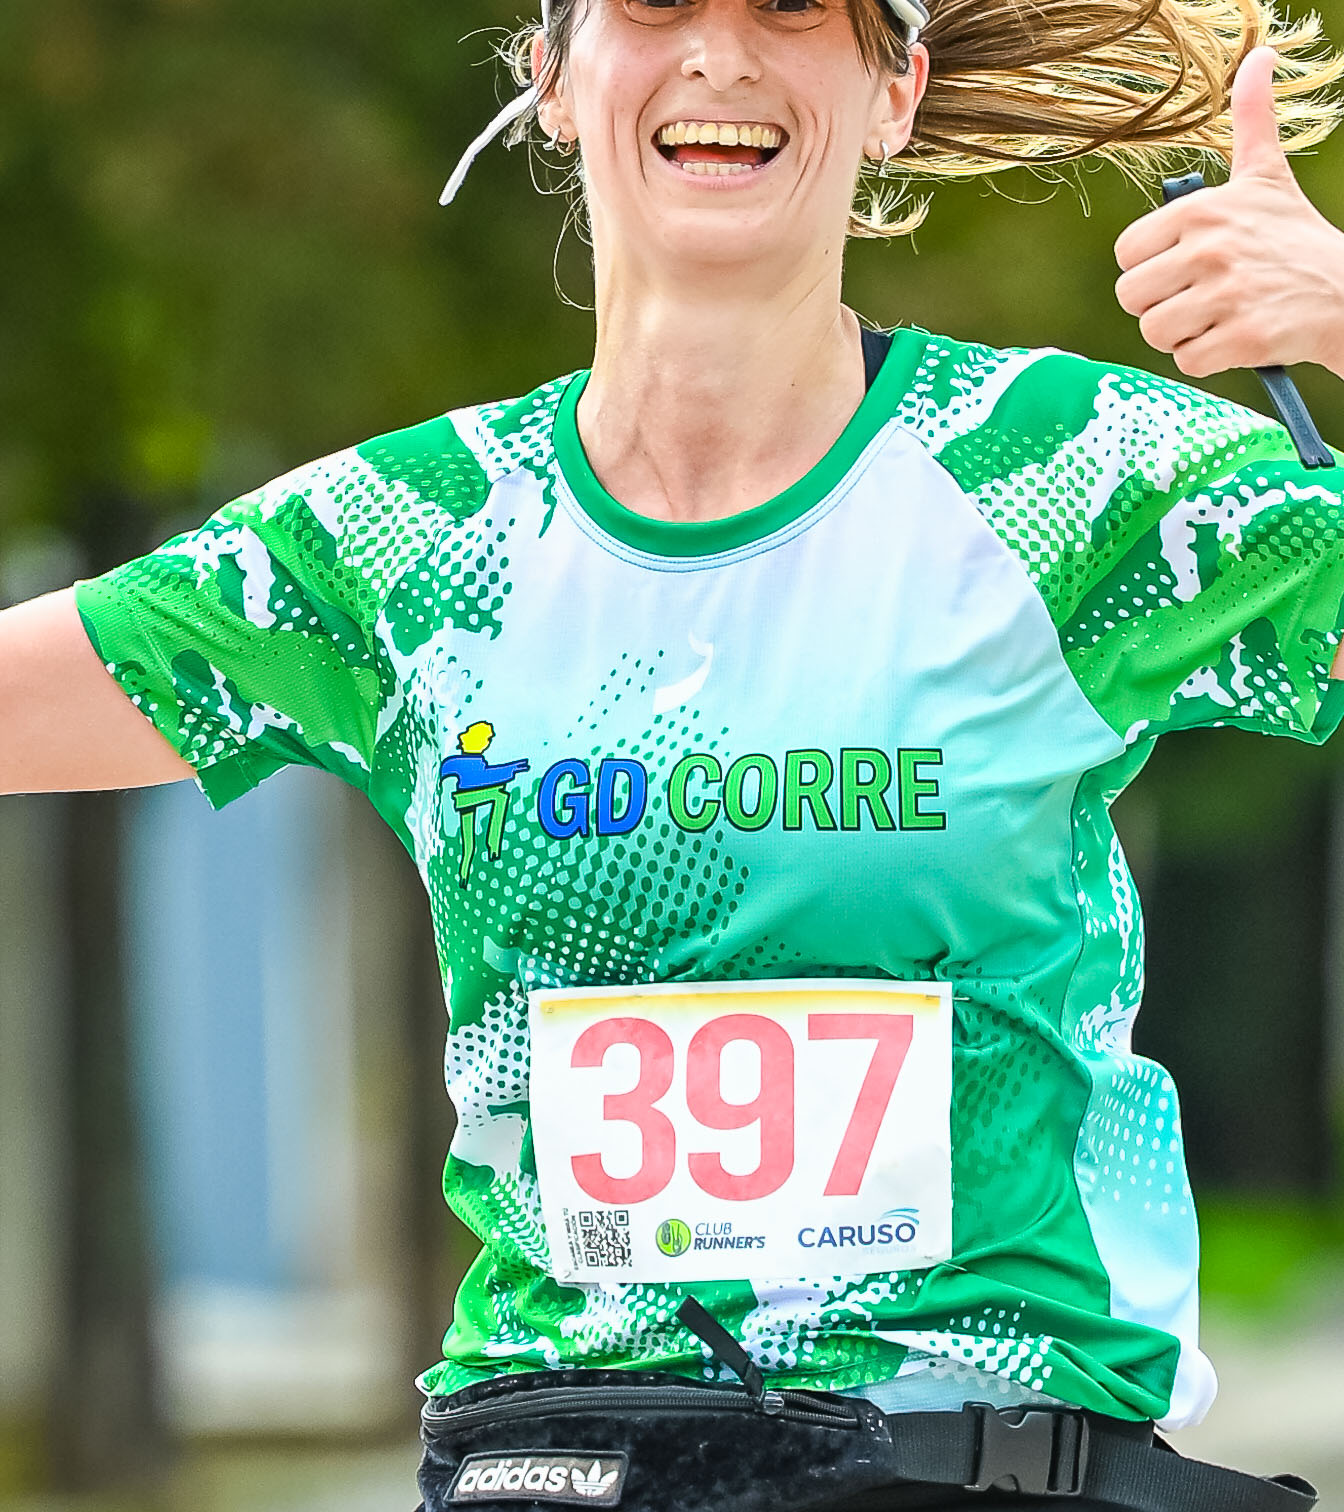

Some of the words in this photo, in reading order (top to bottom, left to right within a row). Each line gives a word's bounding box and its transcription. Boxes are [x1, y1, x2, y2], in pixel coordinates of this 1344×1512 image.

[536, 758, 648, 840] GD
[666, 748, 947, 833] CORRE
[570, 1013, 914, 1205] 397
[693, 1236, 766, 1251] RUNNER'S
[695, 1222, 733, 1236] CLUB
[798, 1222, 916, 1248] CARUSO
[457, 1459, 568, 1493] adidas
